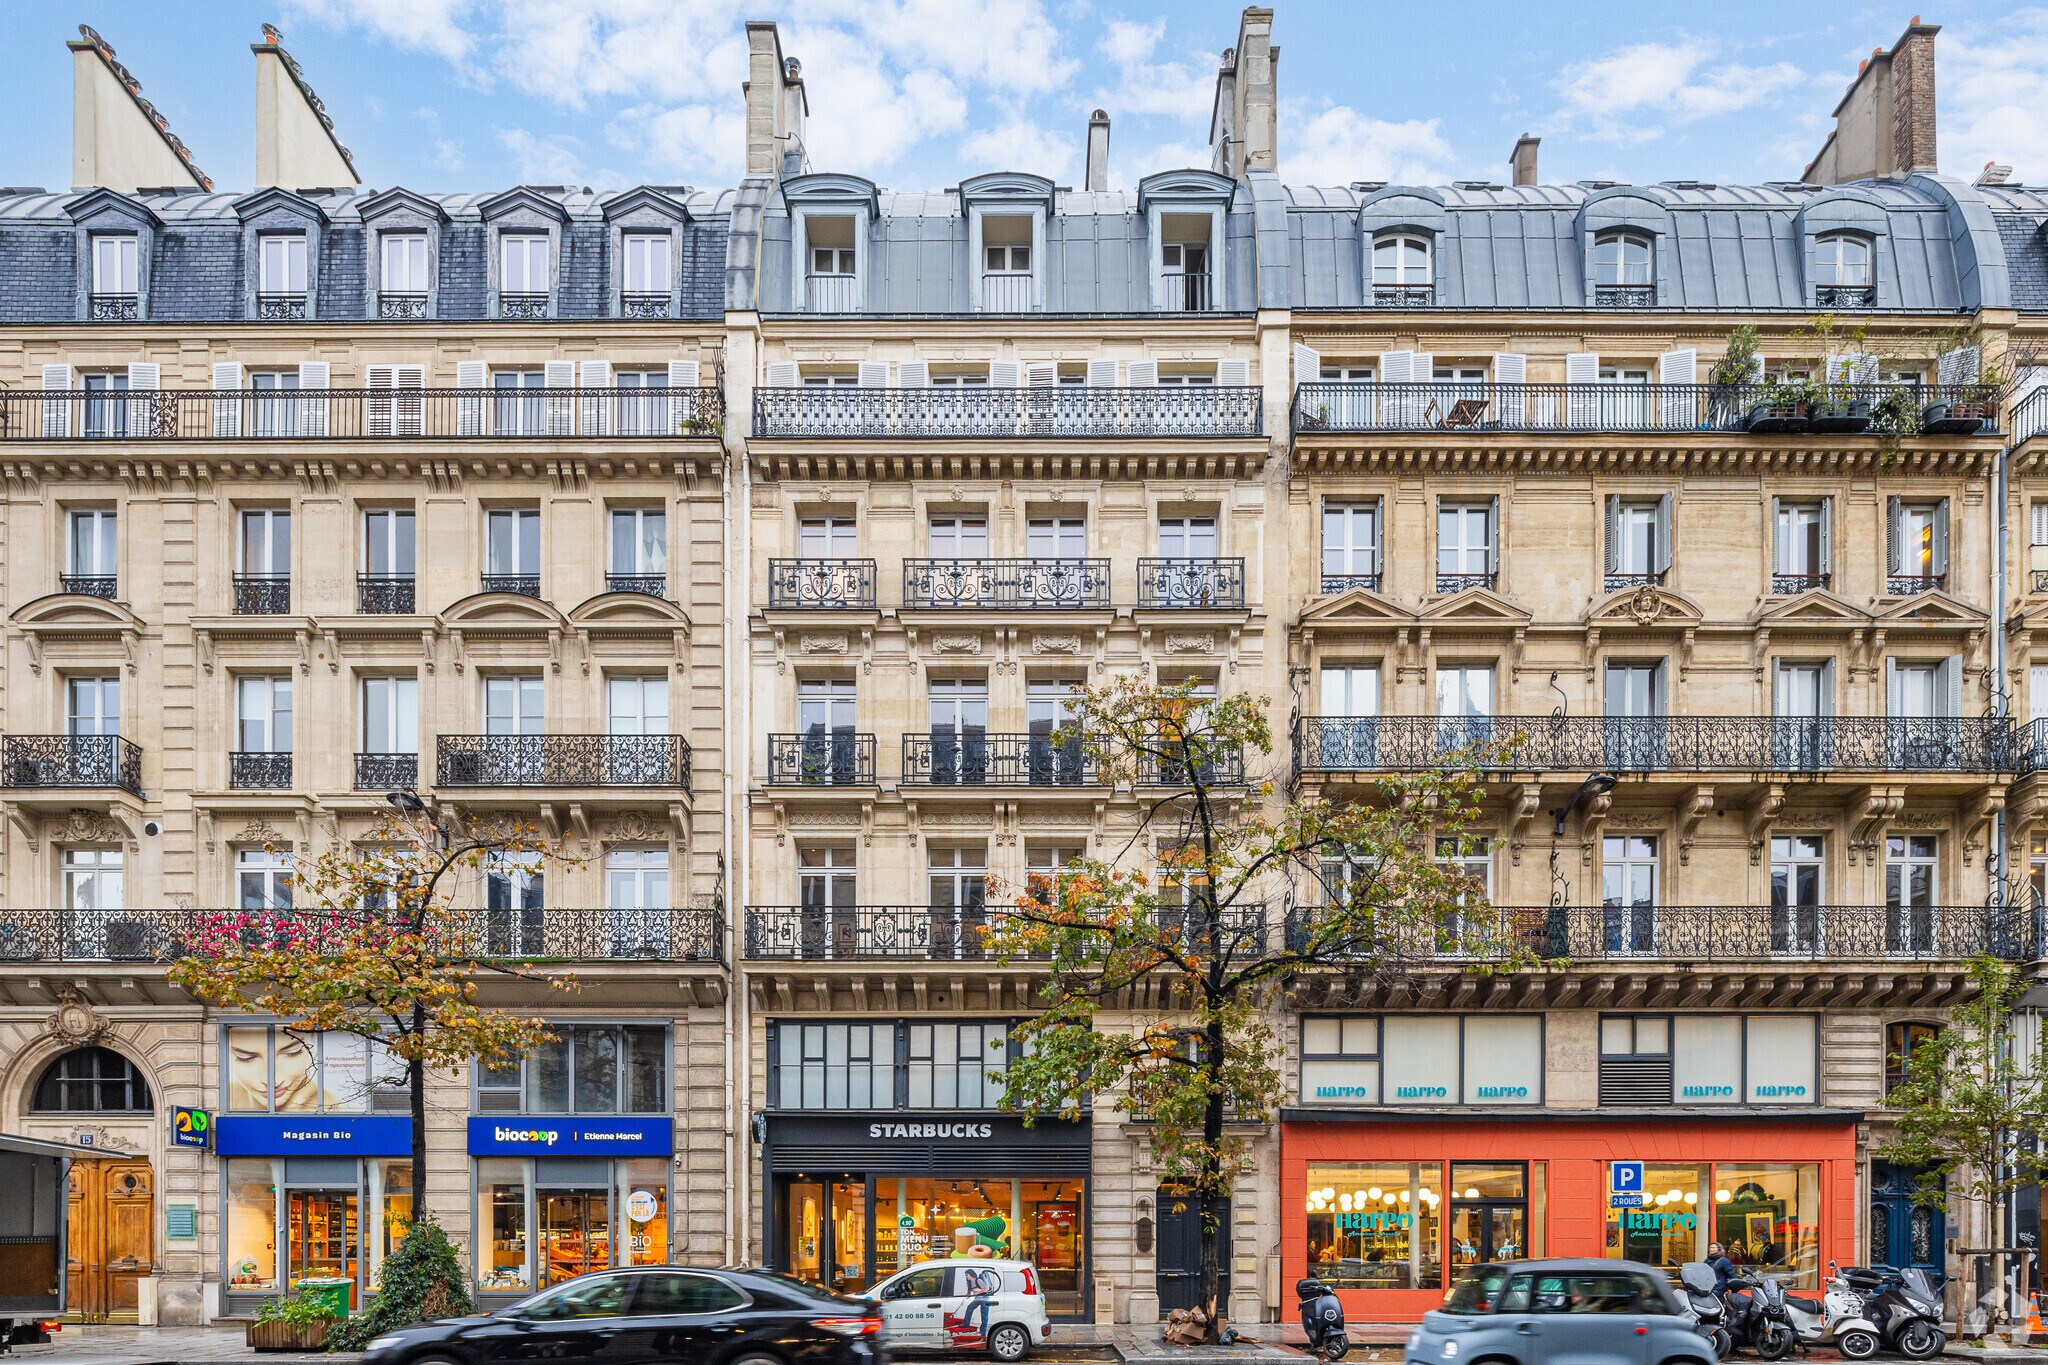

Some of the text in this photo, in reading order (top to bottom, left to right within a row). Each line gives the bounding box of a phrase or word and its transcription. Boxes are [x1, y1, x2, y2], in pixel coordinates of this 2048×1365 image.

[494, 1126, 642, 1145] biocoop Etienne Marcel
[869, 1123, 992, 1138] STARBUCKS
[82, 1136, 92, 1144] 15
[283, 1131, 351, 1141] Magasin Bio
[1620, 1168, 1634, 1187] P
[900, 1234, 929, 1243] MENU
[900, 1243, 922, 1251] DUO
